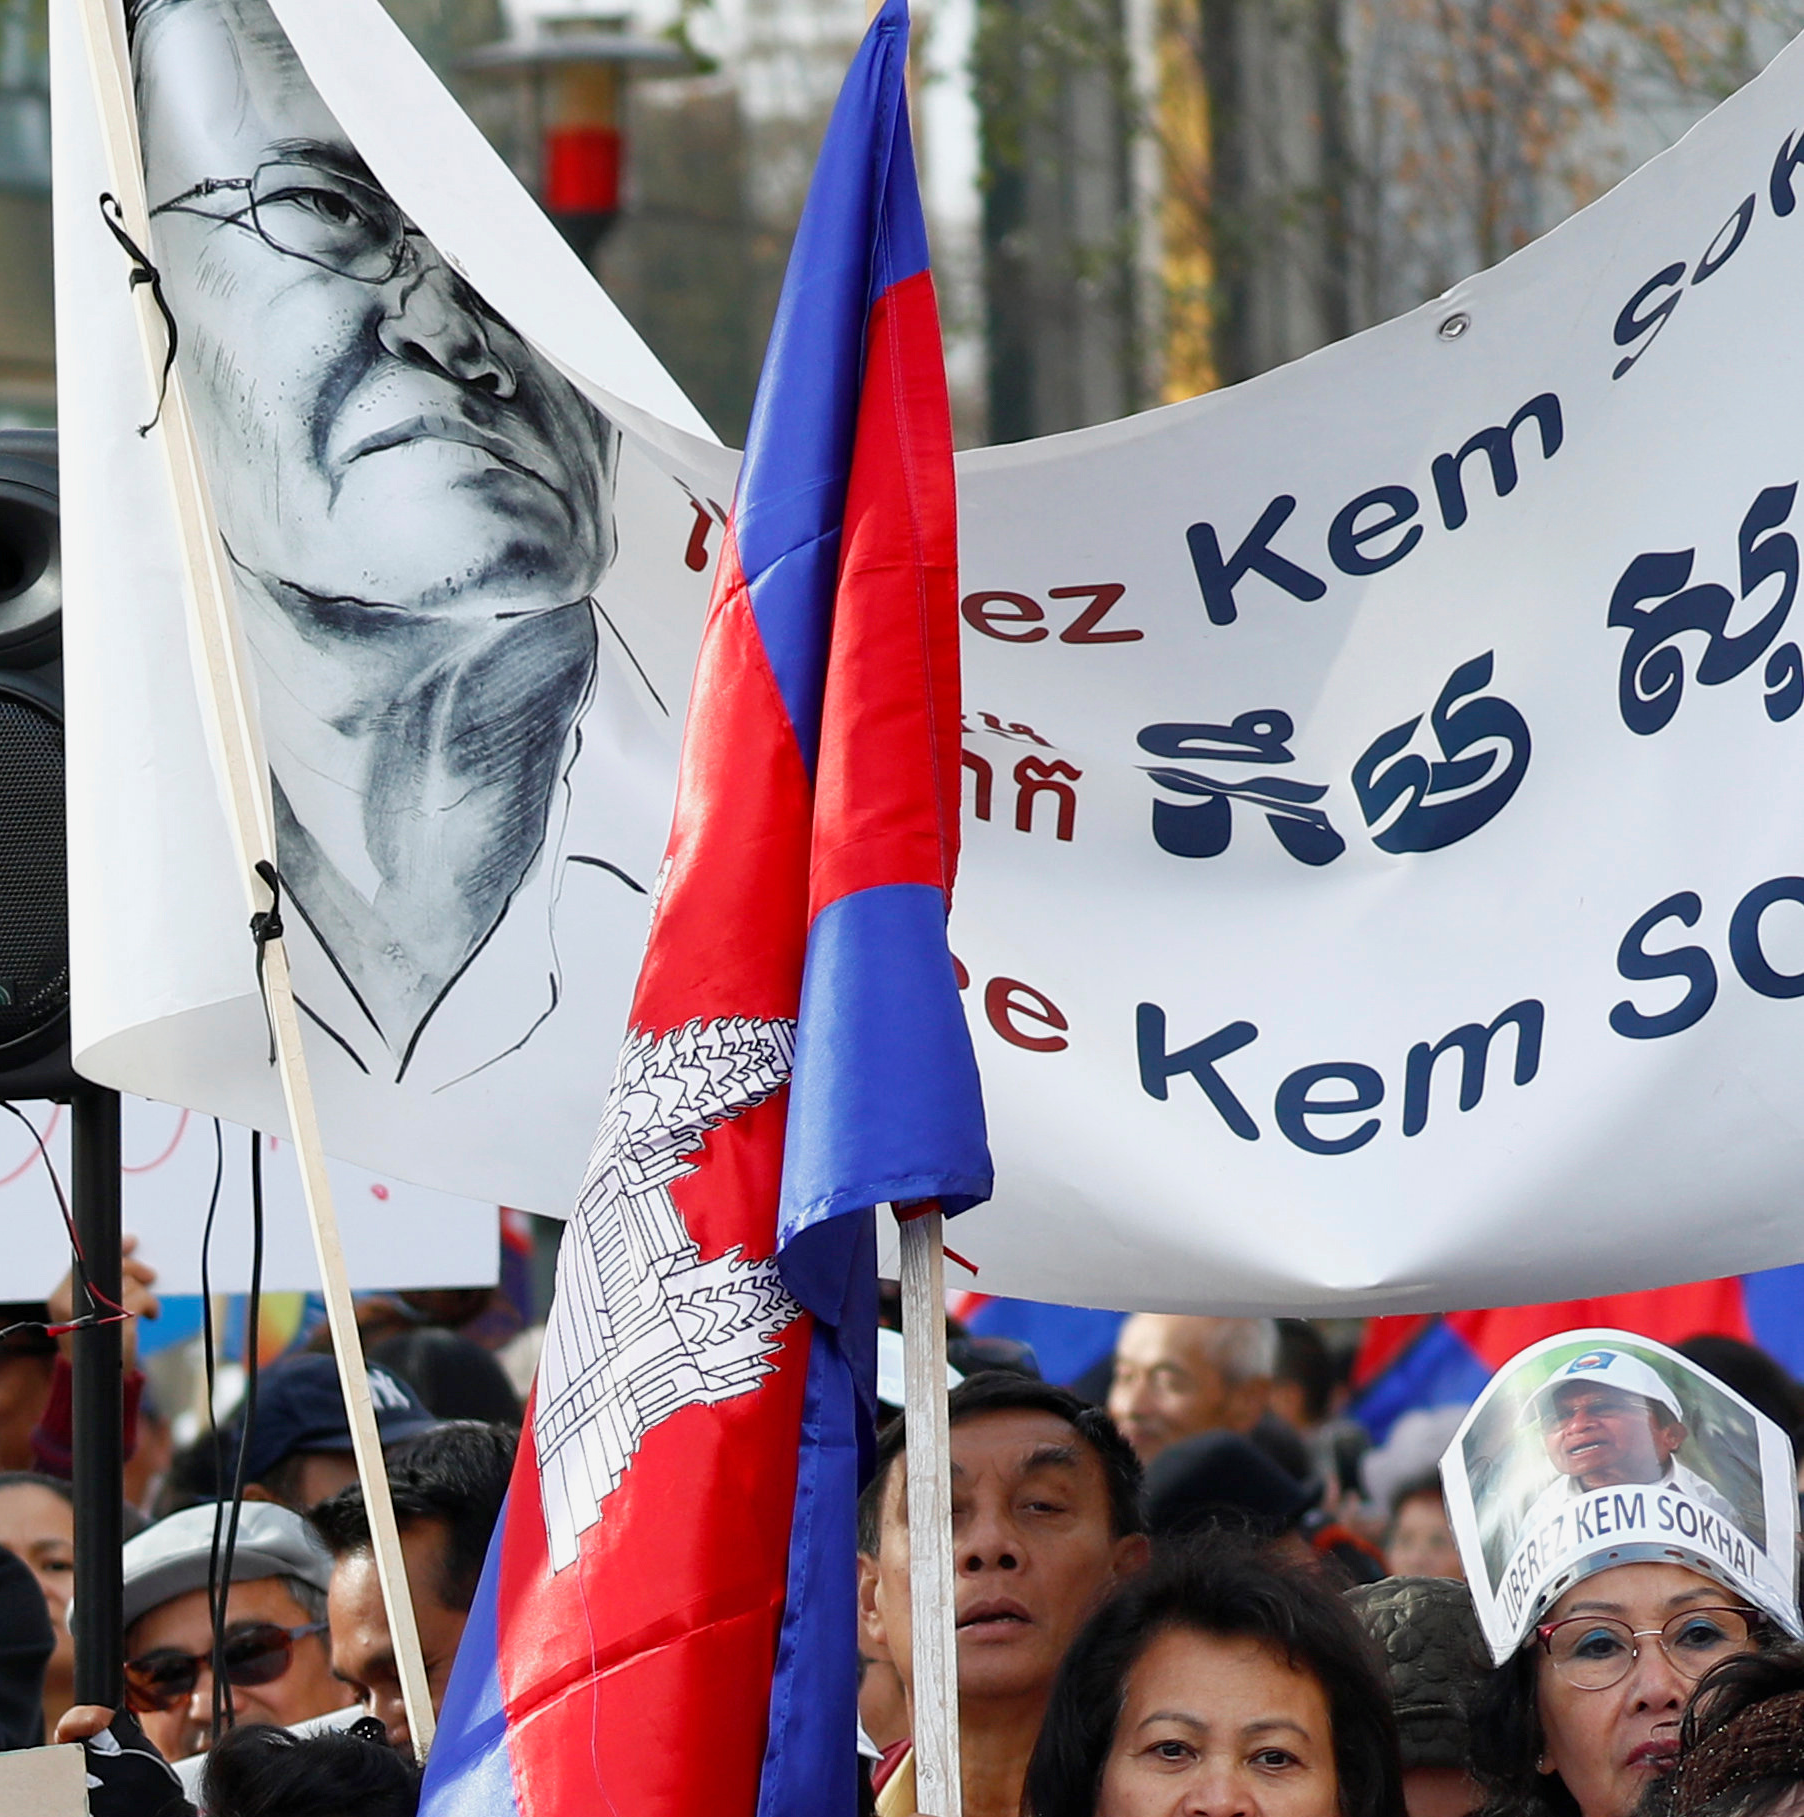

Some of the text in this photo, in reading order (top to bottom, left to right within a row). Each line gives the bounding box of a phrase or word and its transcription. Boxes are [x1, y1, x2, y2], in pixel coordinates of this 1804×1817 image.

[1186, 393, 1563, 626] Kem
[1136, 997, 1544, 1155] Kem
[1501, 1515, 1568, 1634] LIBEREZ
[1575, 1492, 1646, 1544] KEM
